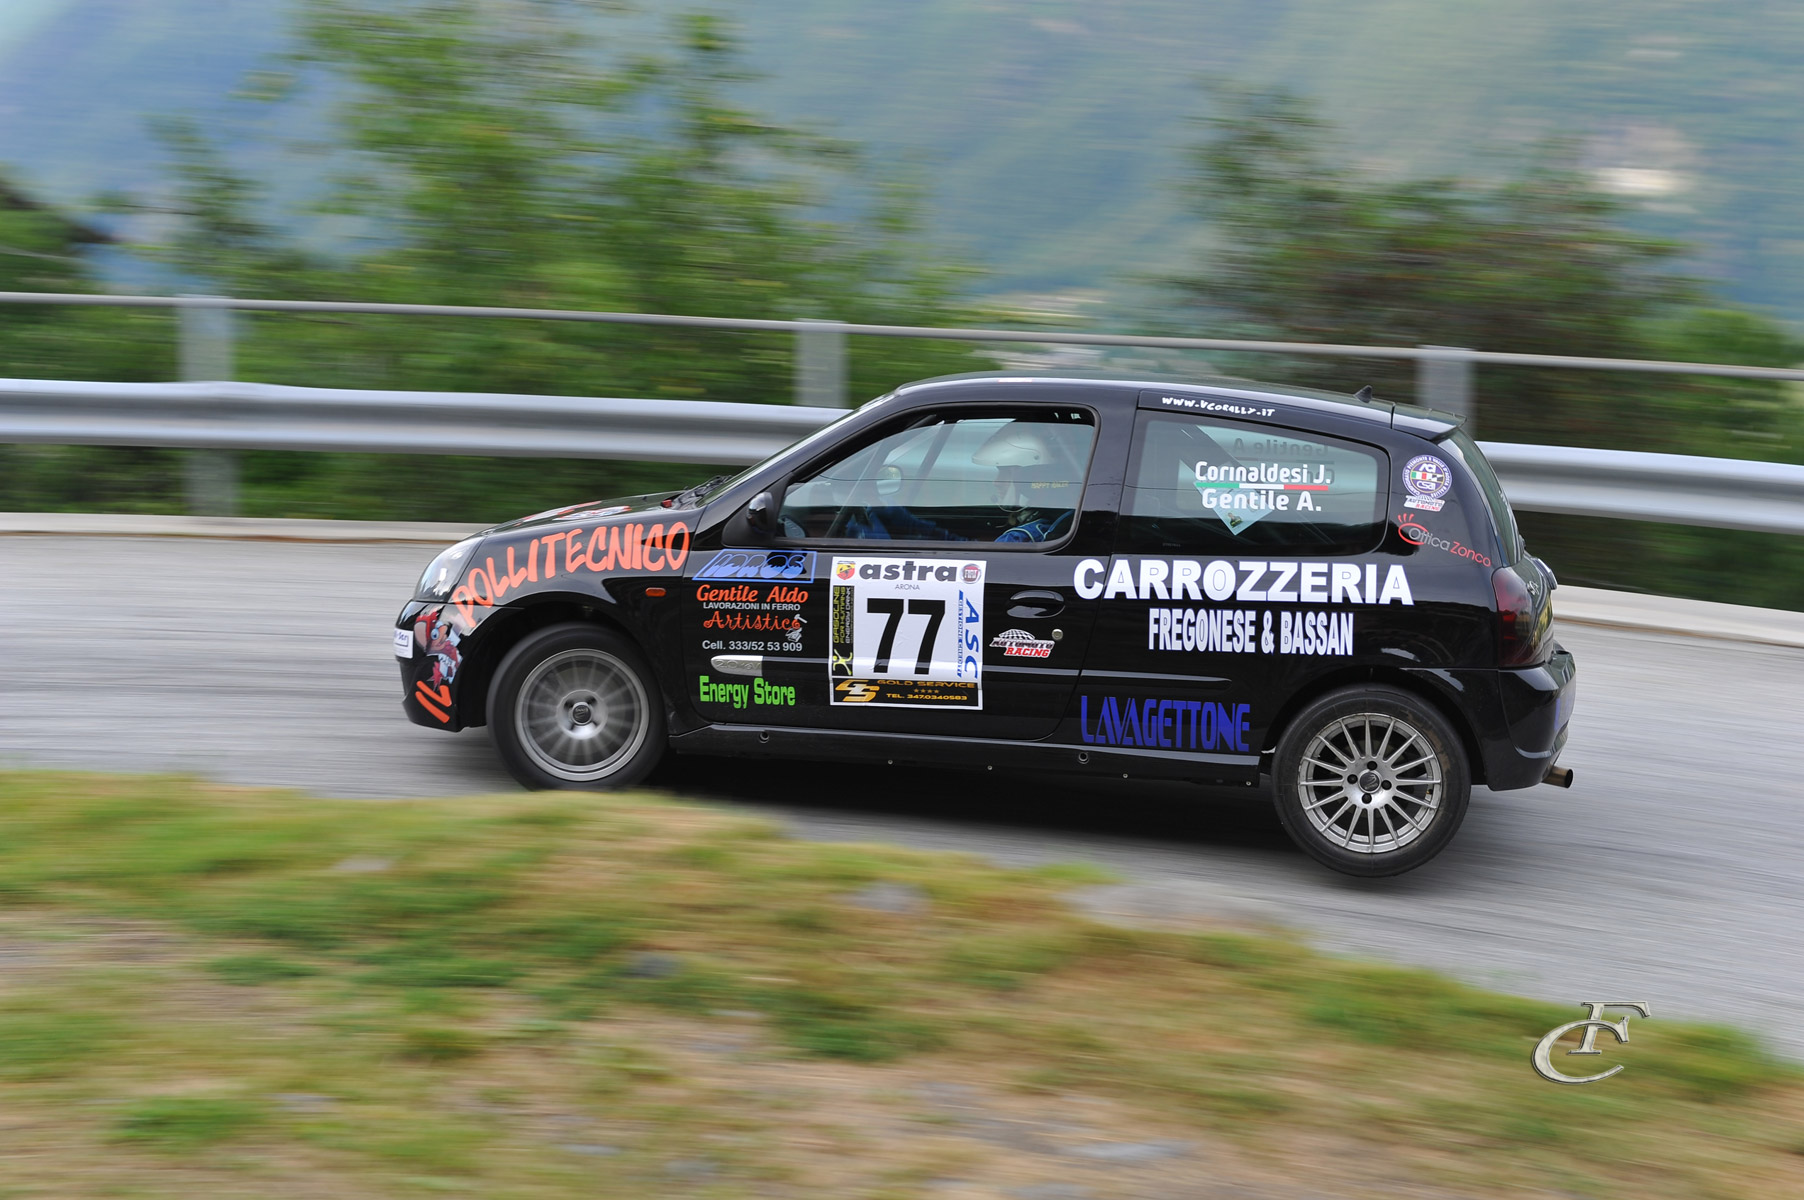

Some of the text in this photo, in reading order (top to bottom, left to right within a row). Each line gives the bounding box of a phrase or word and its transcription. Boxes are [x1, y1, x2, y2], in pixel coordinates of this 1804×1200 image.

[1195, 461, 1309, 483] Corinaldesi
[1313, 465, 1331, 484] J.
[1202, 488, 1322, 512] Gentile A.
[451, 521, 690, 628] POLLITECNICO
[859, 561, 957, 581] astra
[1073, 558, 1415, 606] CARROZZERIA
[696, 584, 809, 604] Gentile Aldo
[703, 602, 760, 611] LAVORAZIONI
[772, 603, 801, 611] FERRO
[702, 640, 803, 651] Cell. 333/52 53 909
[867, 598, 946, 675] 77
[965, 598, 980, 679] ASC
[1148, 608, 1354, 656] FREGONESE & BASSAN
[1005, 647, 1050, 657] RACING
[699, 675, 796, 709] Energy Store
[1081, 695, 1251, 753] LAVAGETTONE
